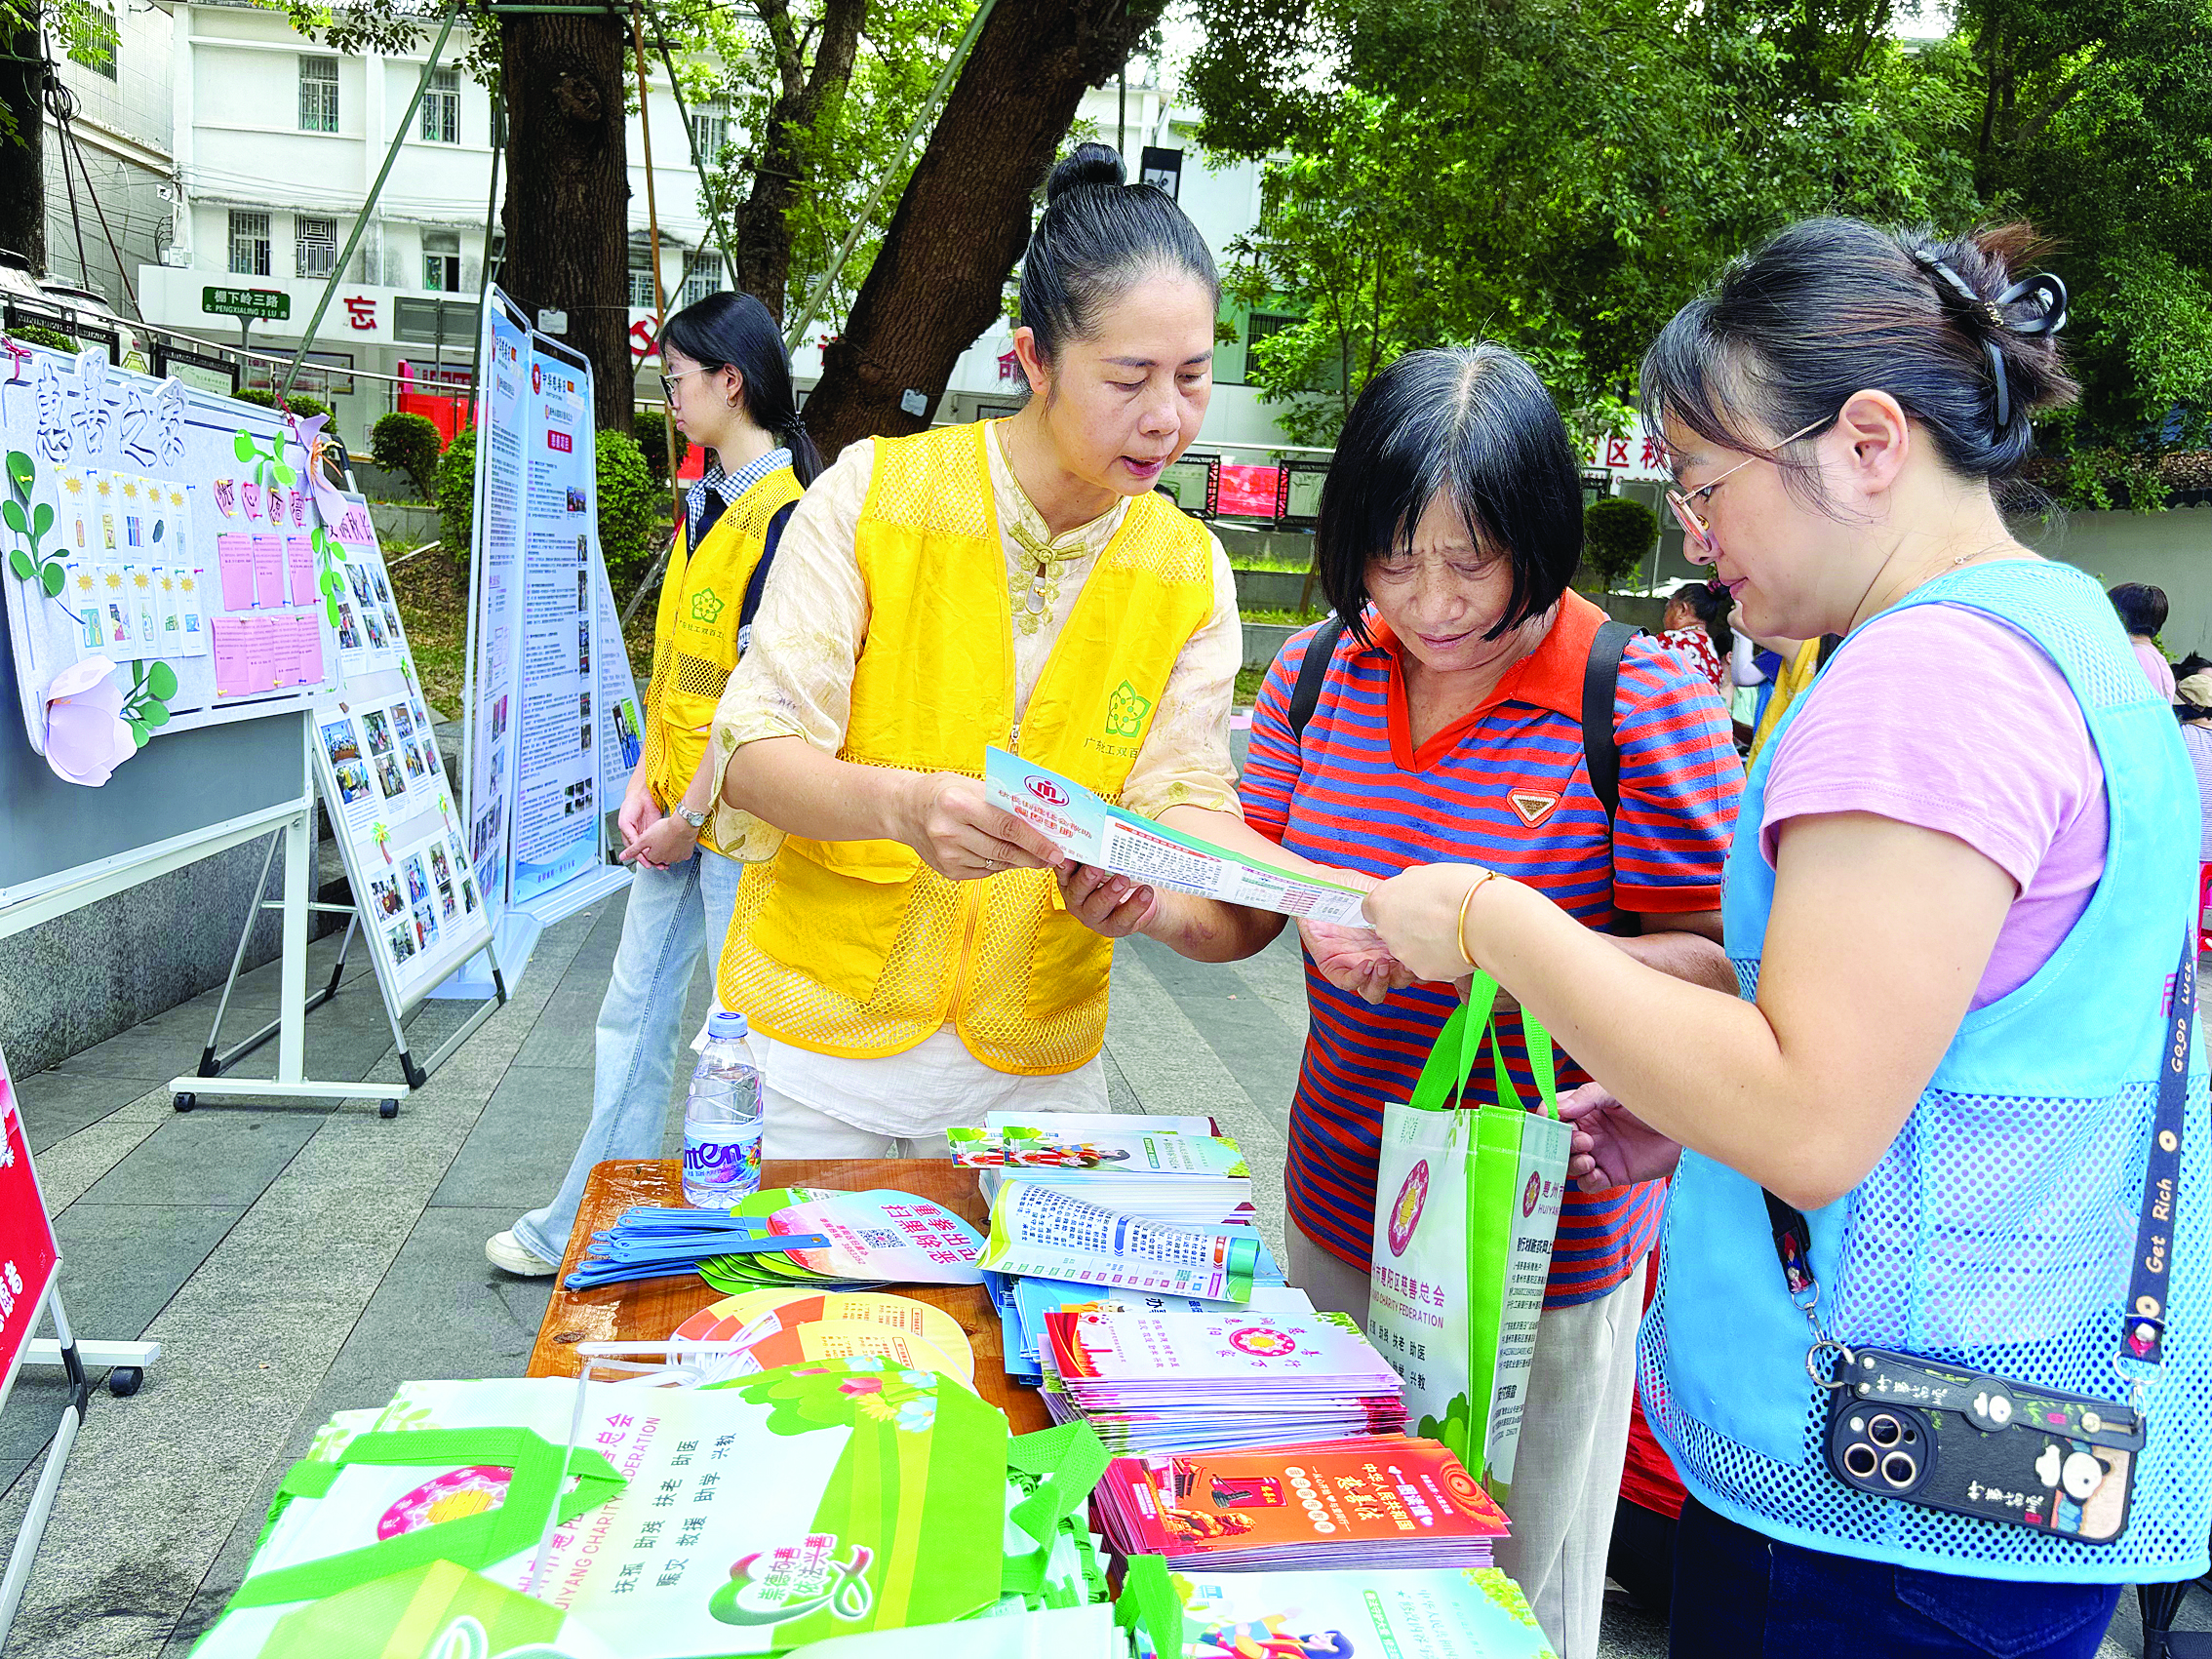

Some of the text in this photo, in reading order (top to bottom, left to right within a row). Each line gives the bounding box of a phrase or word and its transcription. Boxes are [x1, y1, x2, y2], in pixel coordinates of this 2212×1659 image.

[215, 290, 279, 308] 棚下岭三路
[215, 304, 259, 316] PENGXIALING
[260, 308, 266, 317] 3
[267, 309, 277, 318] LU
[343, 296, 377, 330] 忘
[881, 1205, 961, 1264] 扫黑除恶
[2145, 1177, 2173, 1274] Get Rich
[1399, 1302, 1444, 1329] FEDERATION
[554, 1416, 661, 1611] UIYANG CHARITY DERATION
[633, 1520, 666, 1549] 助残
[652, 1479, 683, 1507] 扶老
[671, 1440, 700, 1466] 助医
[675, 1516, 708, 1547] 救援
[693, 1472, 721, 1502] 助学
[710, 1433, 737, 1460] 兴教
[1334, 1476, 1385, 1521] 慈善法
[1362, 1463, 1416, 1530] 中华人民共和国
[758, 1547, 802, 1600] 崇德向善
[1417, 1590, 1460, 1659] 中华人民共和国
